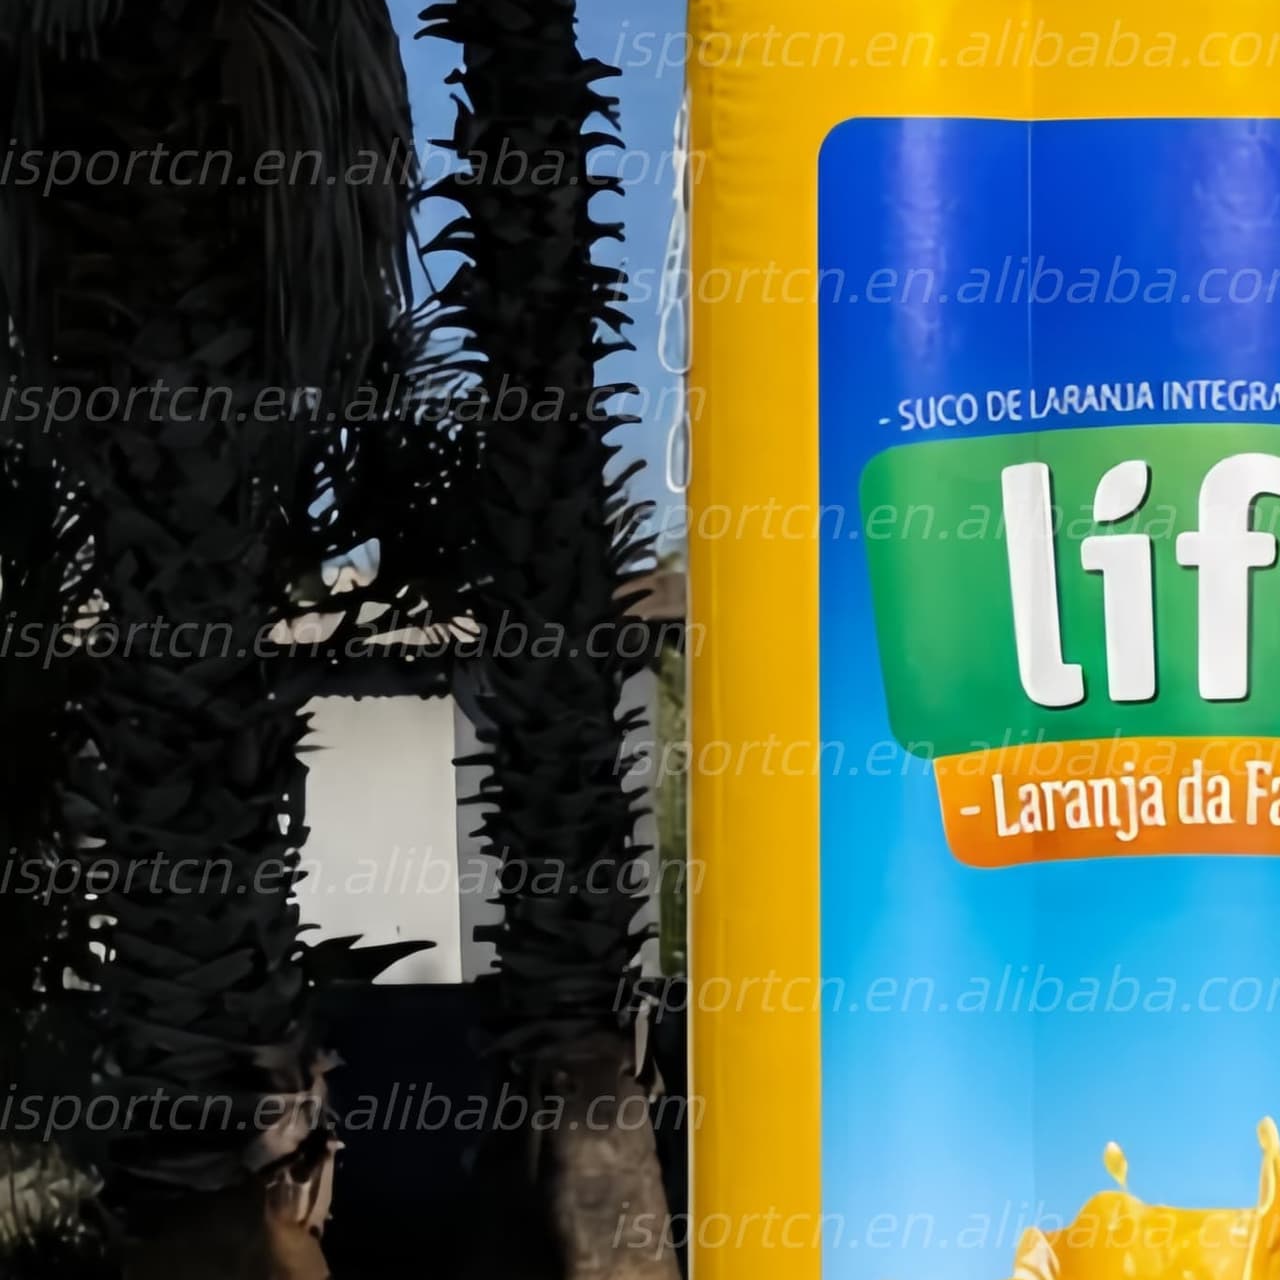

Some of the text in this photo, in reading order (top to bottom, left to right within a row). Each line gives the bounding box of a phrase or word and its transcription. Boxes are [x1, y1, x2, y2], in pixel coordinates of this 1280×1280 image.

[900, 392, 979, 431] SUCO
[986, 388, 1023, 422] DE
[1029, 381, 1155, 419] LARANJA
[991, 762, 1166, 842] Laranja
[1178, 759, 1235, 825] da
